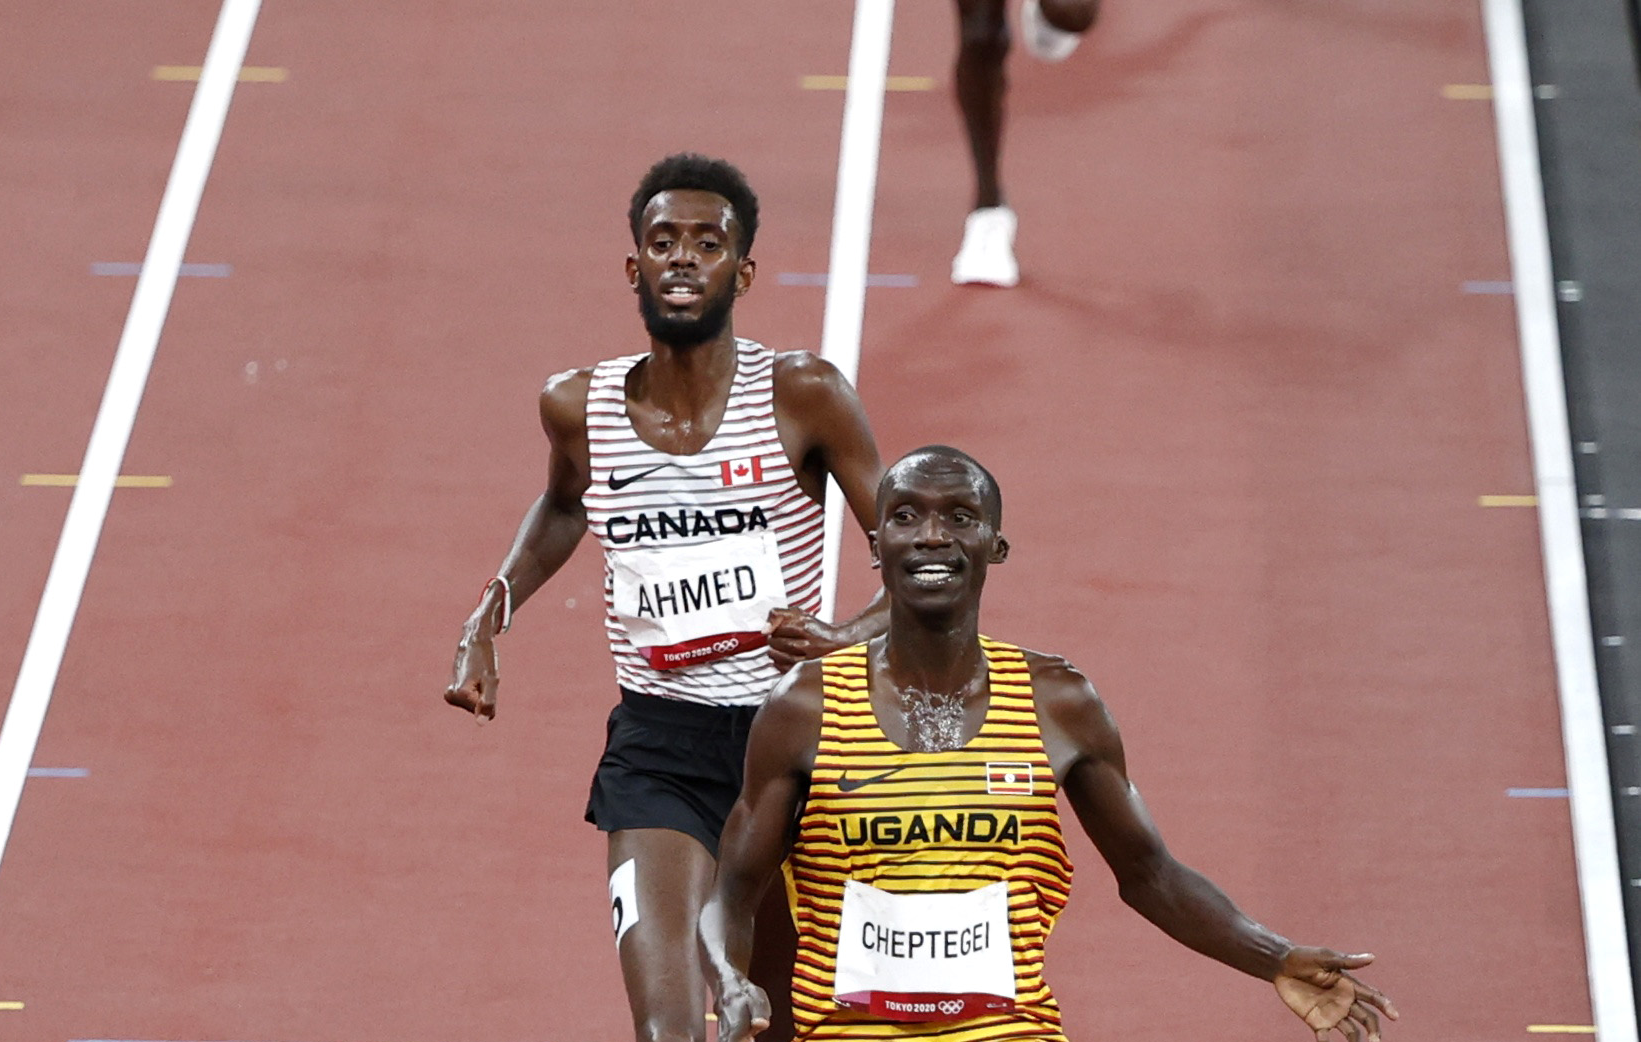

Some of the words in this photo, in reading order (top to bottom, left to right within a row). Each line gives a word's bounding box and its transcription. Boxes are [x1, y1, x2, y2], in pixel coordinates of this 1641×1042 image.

[605, 505, 769, 544] CANADA
[637, 564, 757, 619] AHMED
[663, 650, 691, 662] TOKYO
[839, 812, 1021, 846] UGANDA
[862, 921, 990, 959] CHEPTEGEI
[885, 1000, 913, 1012] TOKYO
[914, 1003, 936, 1012] 2020
